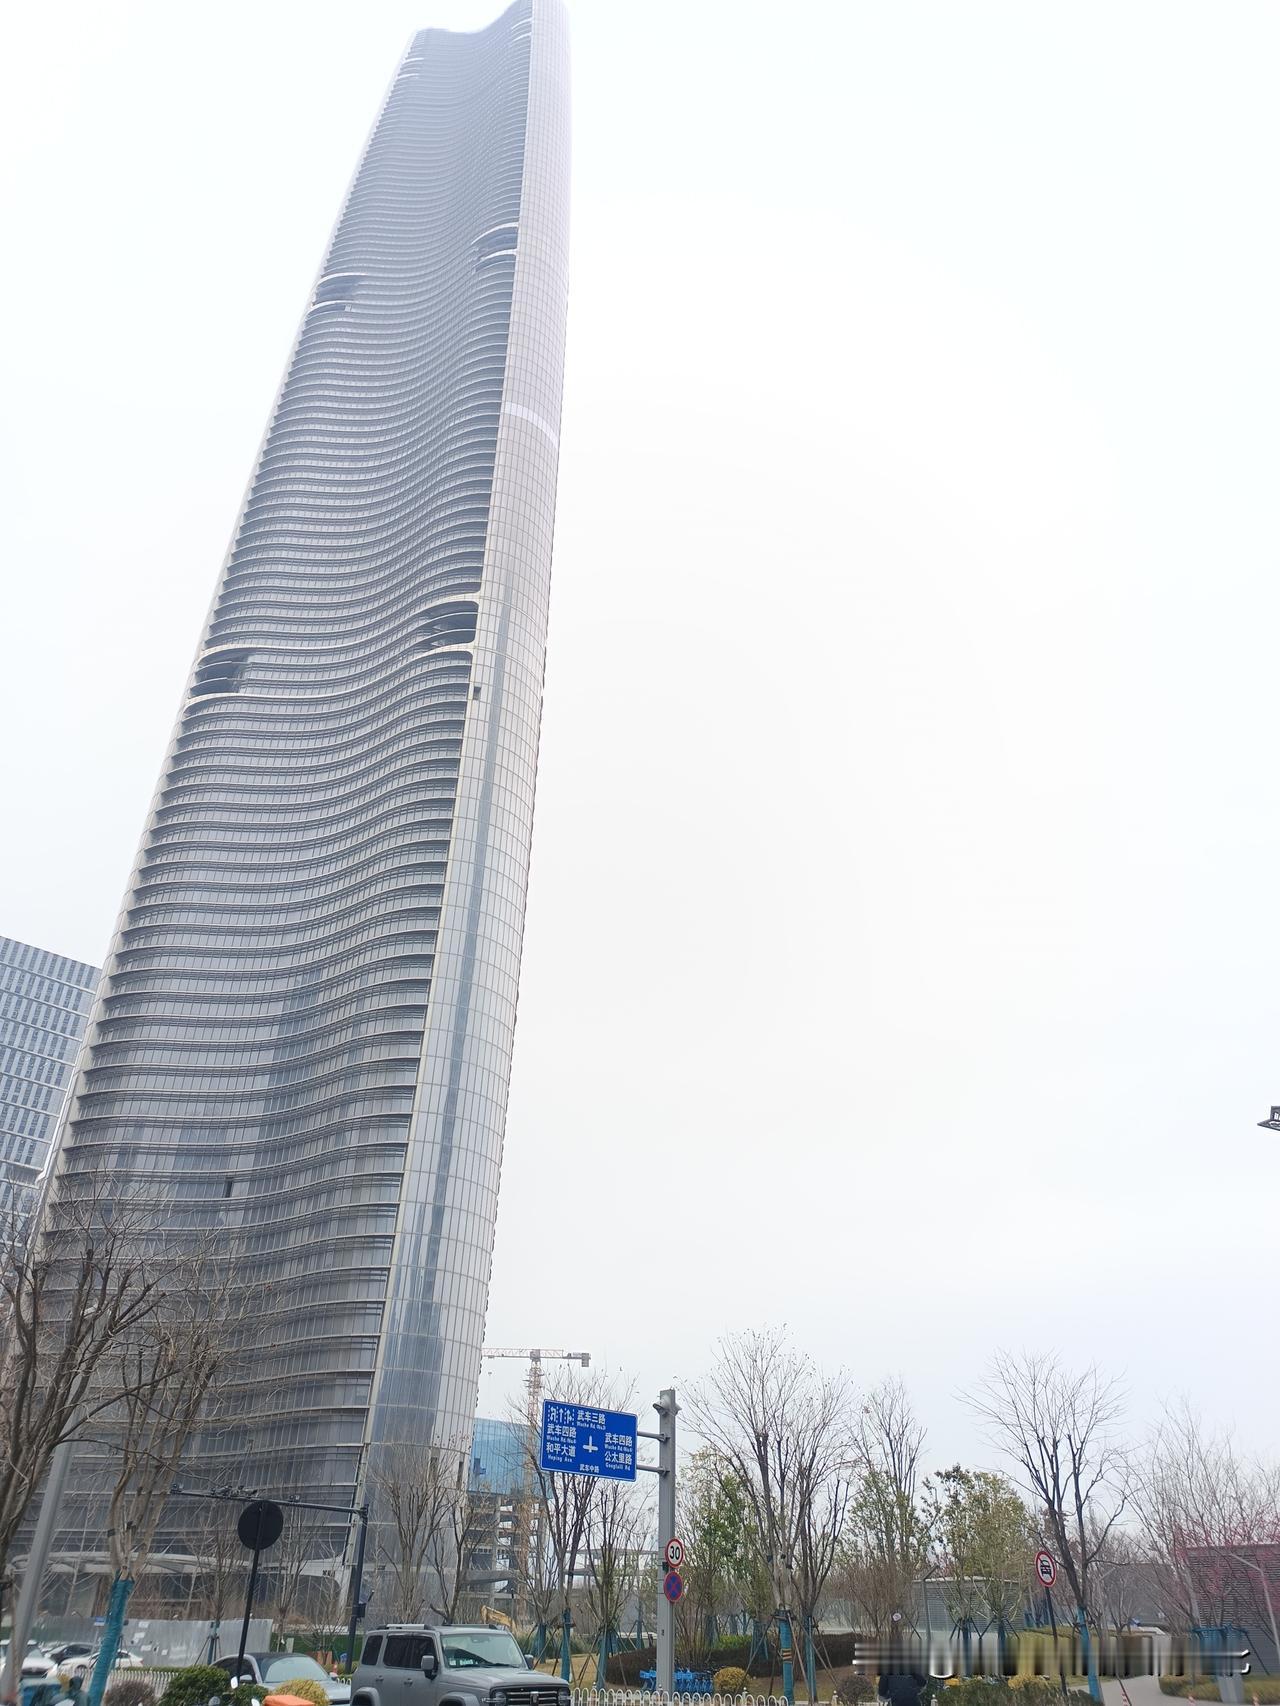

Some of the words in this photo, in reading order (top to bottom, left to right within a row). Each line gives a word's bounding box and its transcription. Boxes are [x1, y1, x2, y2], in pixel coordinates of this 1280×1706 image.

[577, 1410, 606, 1424] 武车三路
[547, 1423, 577, 1438] 武车四路
[605, 1432, 632, 1447] 武车四路
[546, 1442, 576, 1457] 和平大道
[604, 1451, 632, 1465] 公太里路
[669, 1545, 681, 1560] 30
